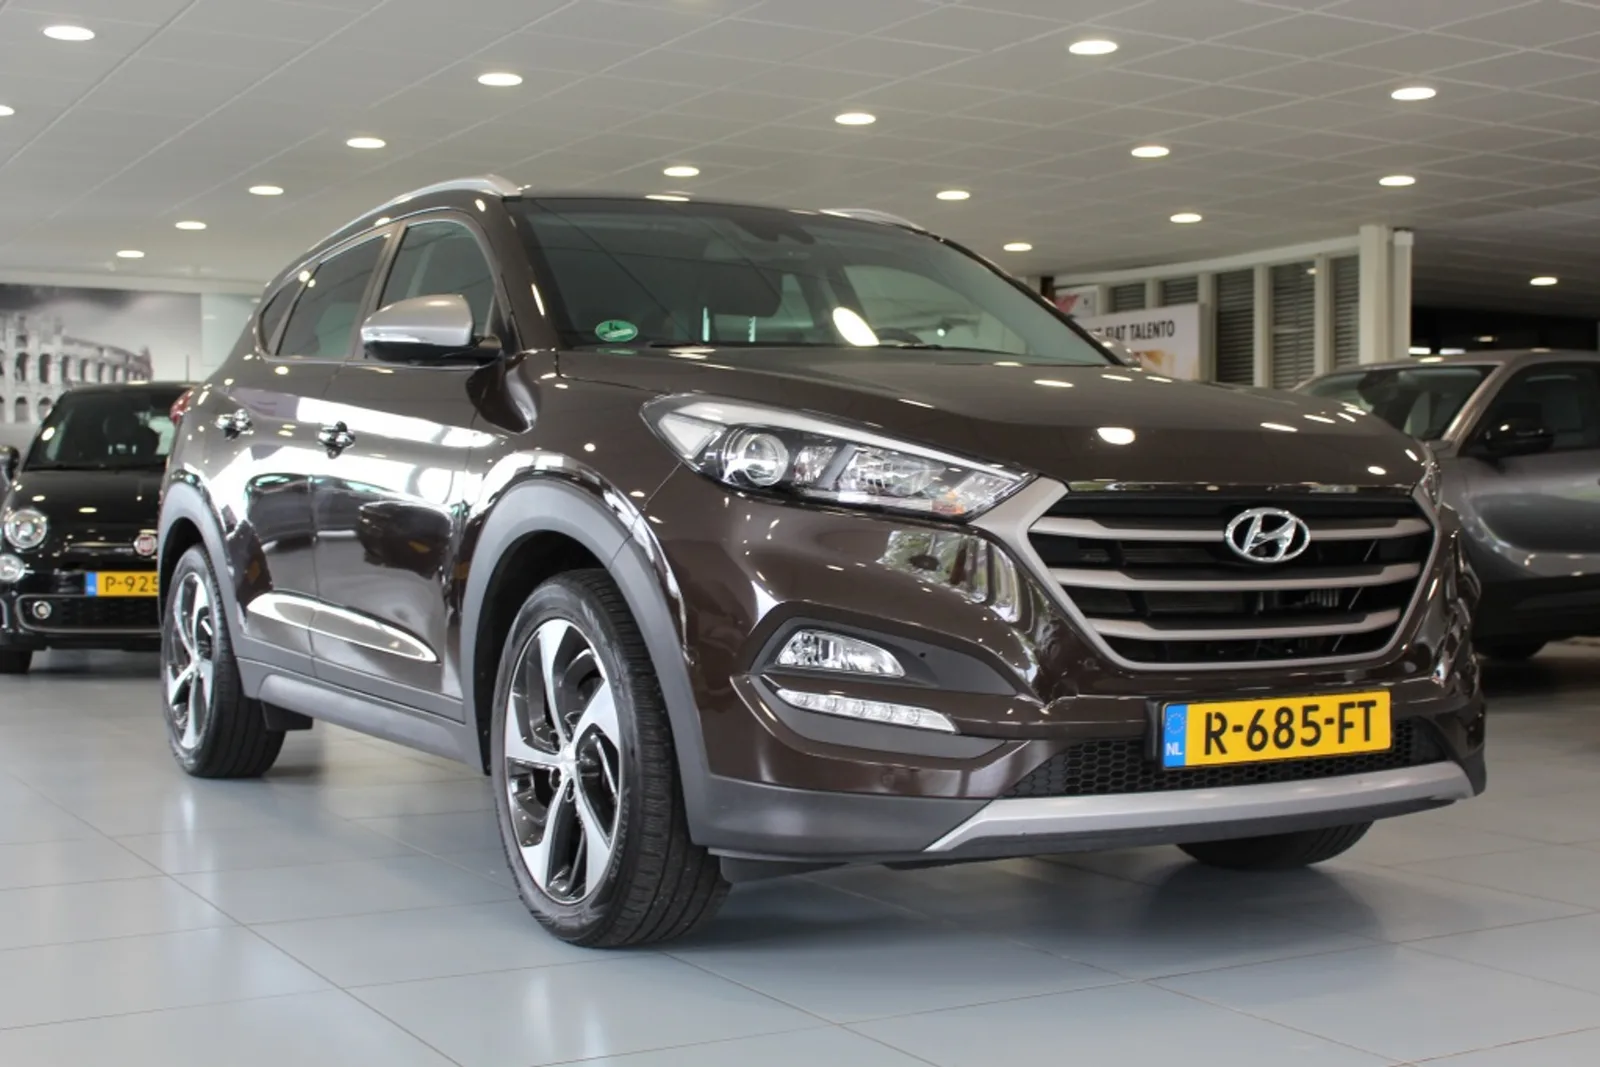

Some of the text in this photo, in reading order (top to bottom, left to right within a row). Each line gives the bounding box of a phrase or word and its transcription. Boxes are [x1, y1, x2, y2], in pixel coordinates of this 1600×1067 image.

[1130, 320, 1175, 340] TALENTO
[1204, 700, 1377, 755] R-685-FT
[1165, 742, 1183, 756] NL
